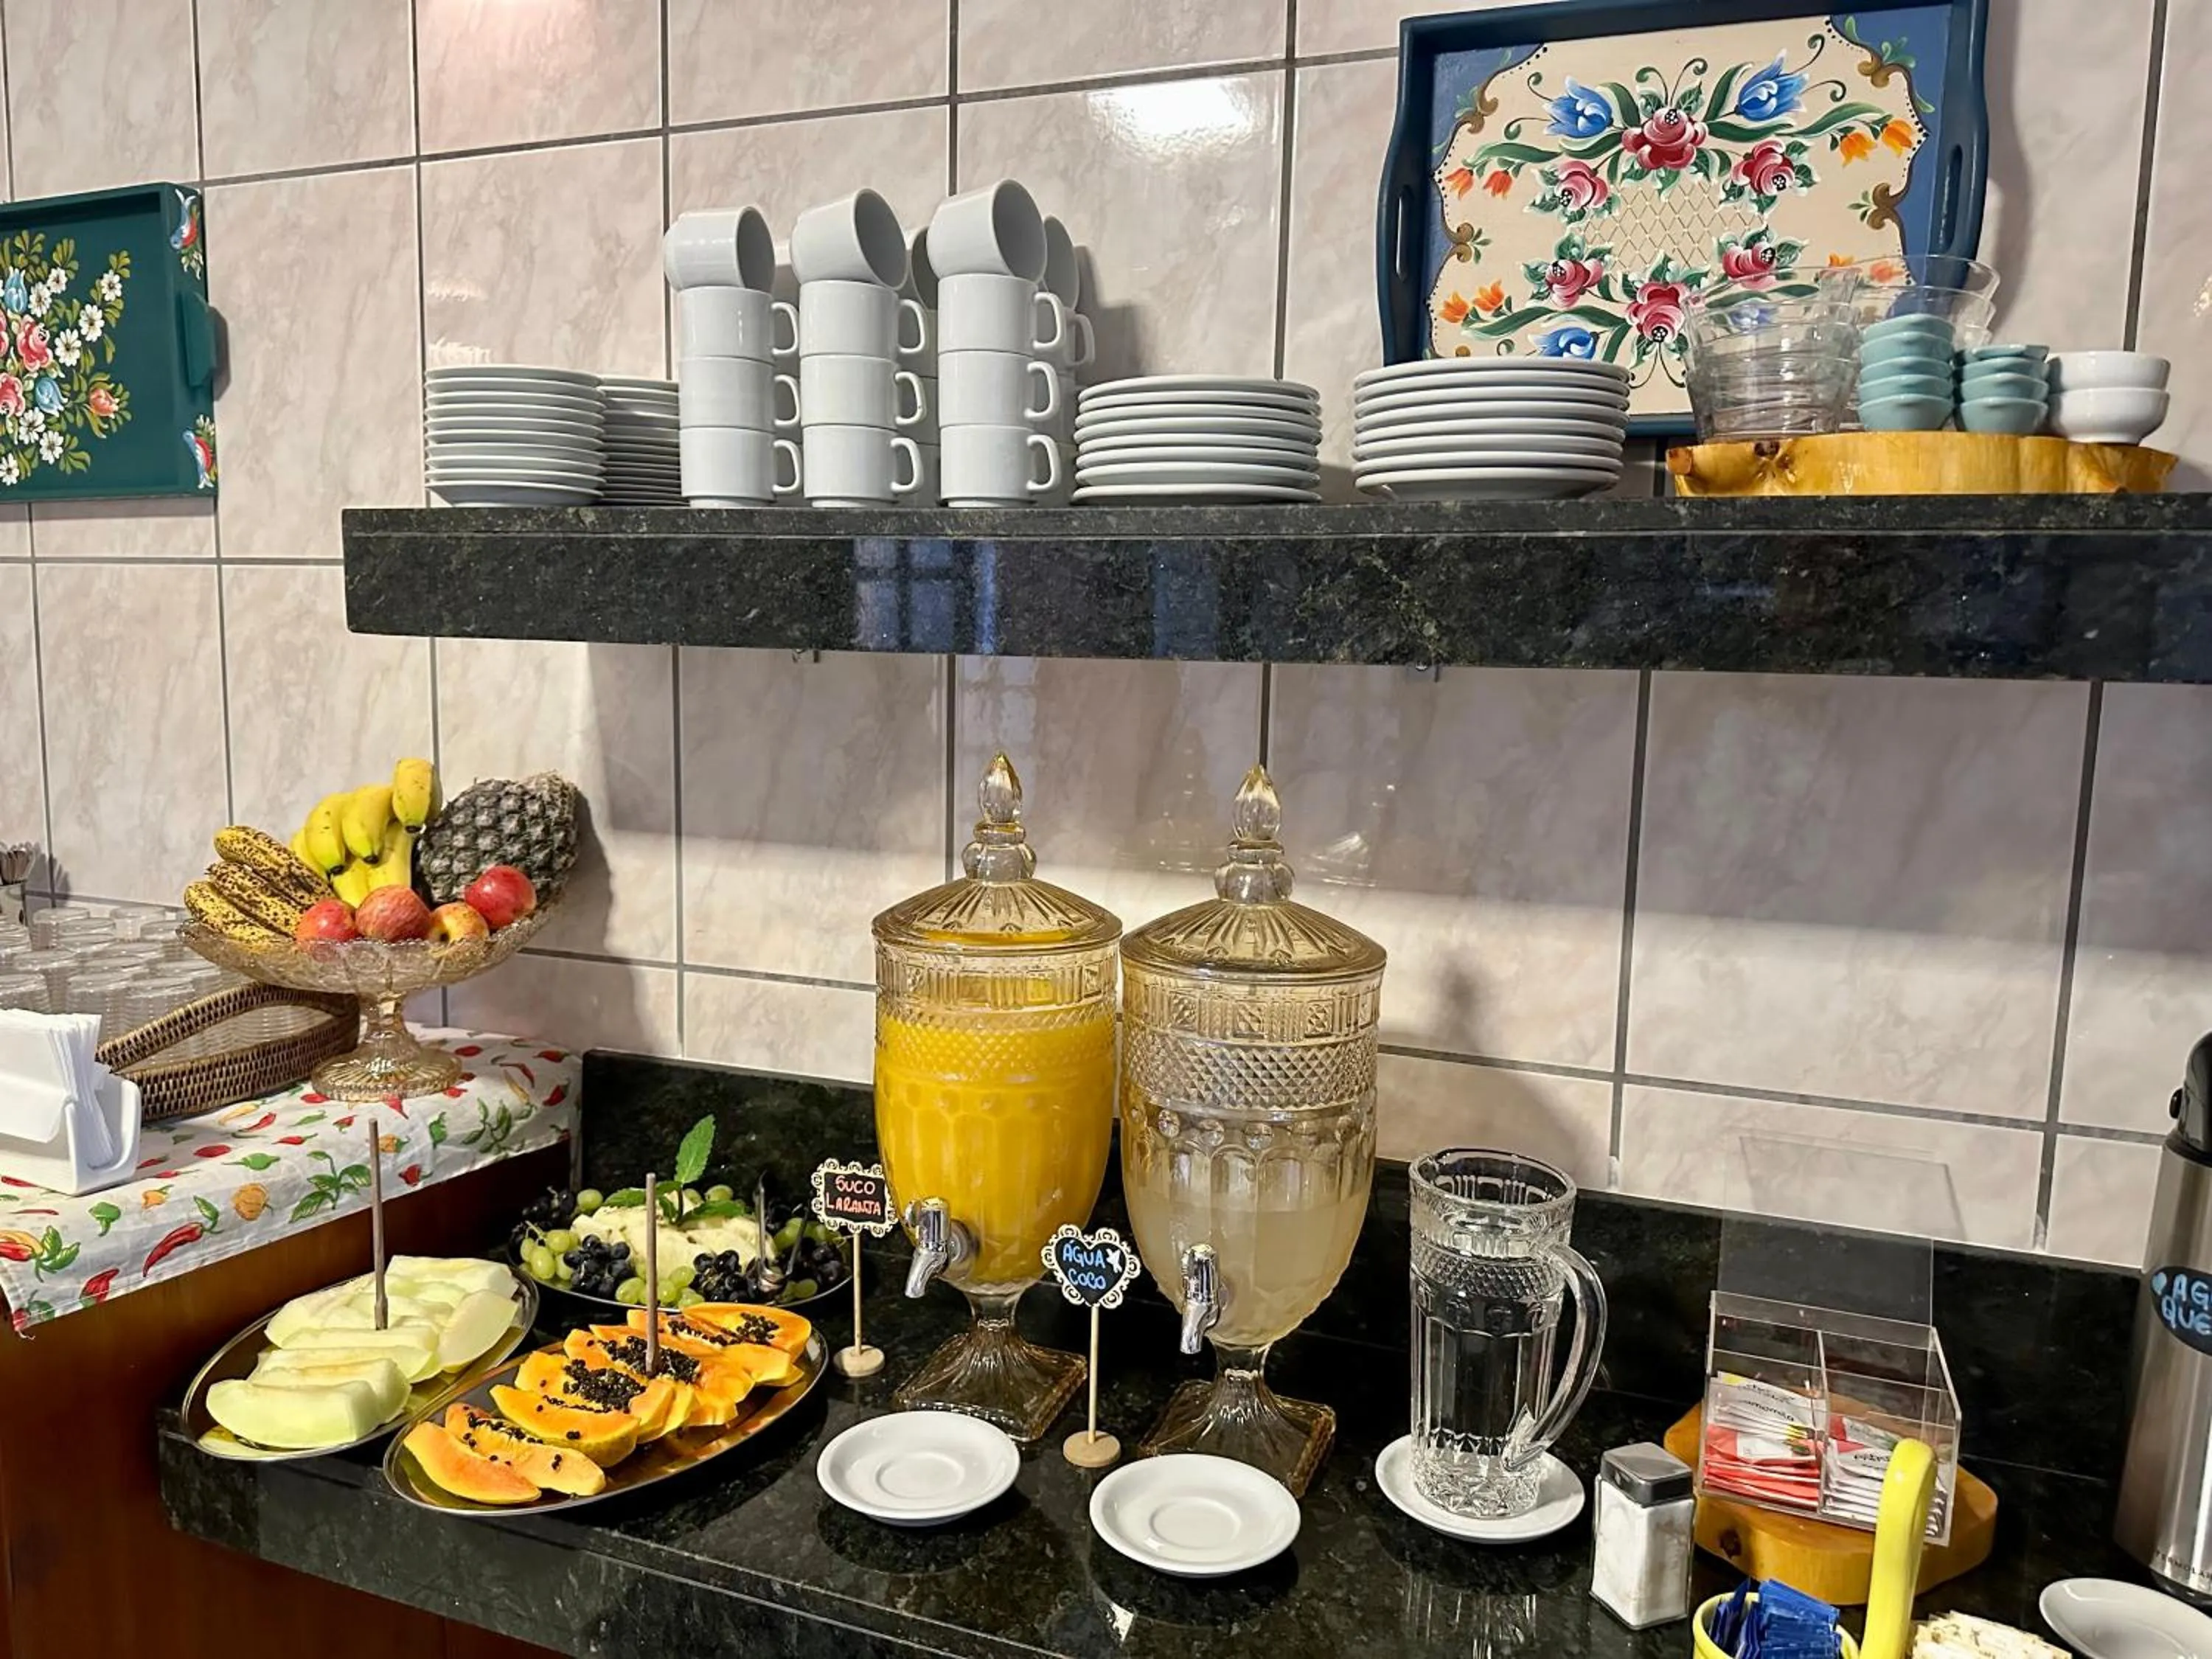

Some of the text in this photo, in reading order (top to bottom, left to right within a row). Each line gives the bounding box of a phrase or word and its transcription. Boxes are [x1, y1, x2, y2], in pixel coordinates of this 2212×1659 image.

[835, 1175, 876, 1194] SUCO
[826, 1192, 882, 1216] LARANJA
[1062, 1239, 1106, 1269] ÁGUA
[1068, 1267, 1106, 1290] COCO
[2172, 1273, 2212, 1311] AG
